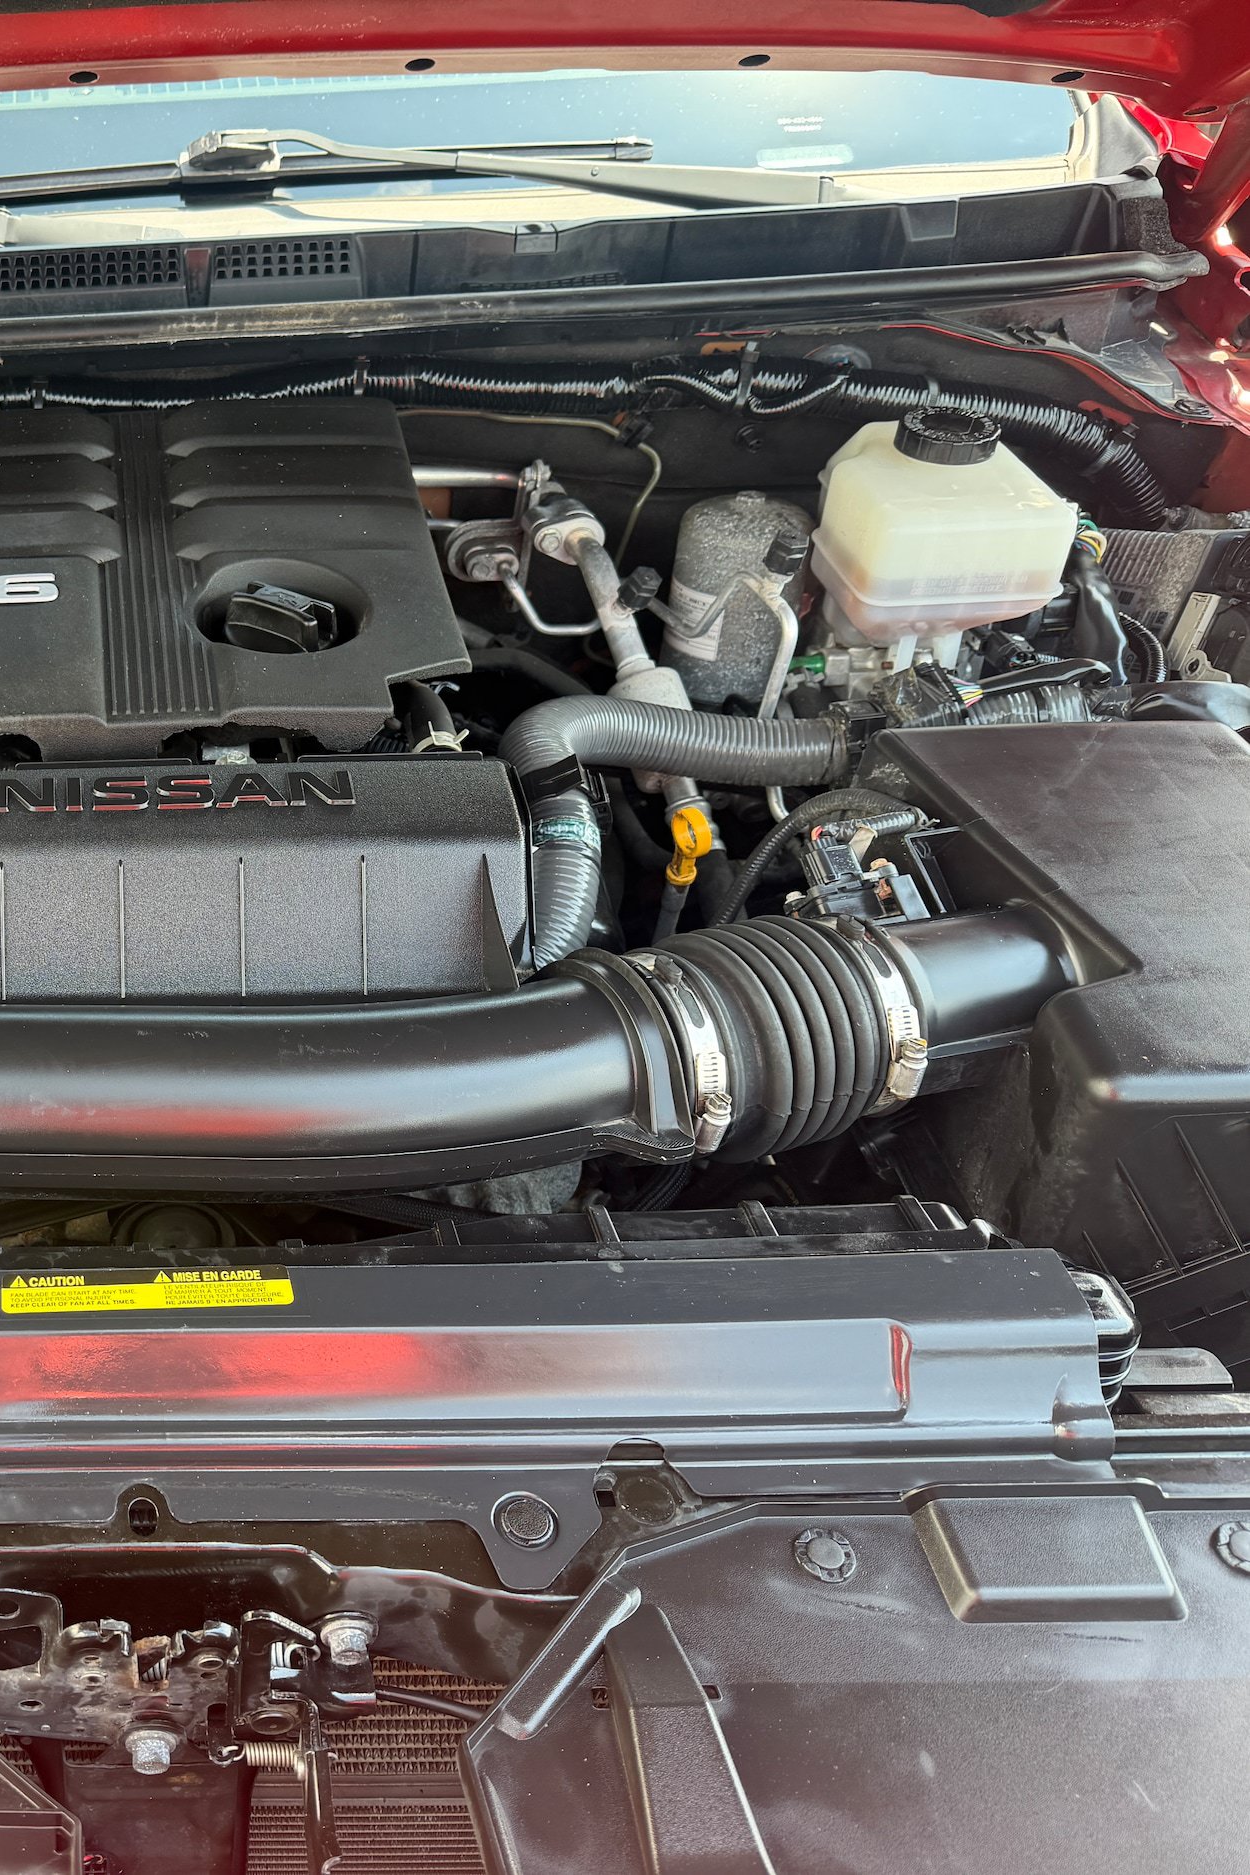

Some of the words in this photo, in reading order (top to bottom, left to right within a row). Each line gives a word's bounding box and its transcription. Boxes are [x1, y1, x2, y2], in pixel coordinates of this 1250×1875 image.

[28, 1275, 84, 1287] CAUTION
[172, 1271, 201, 1282] MISE
[202, 1271, 218, 1281] EN
[220, 1269, 261, 1280] GARDE
